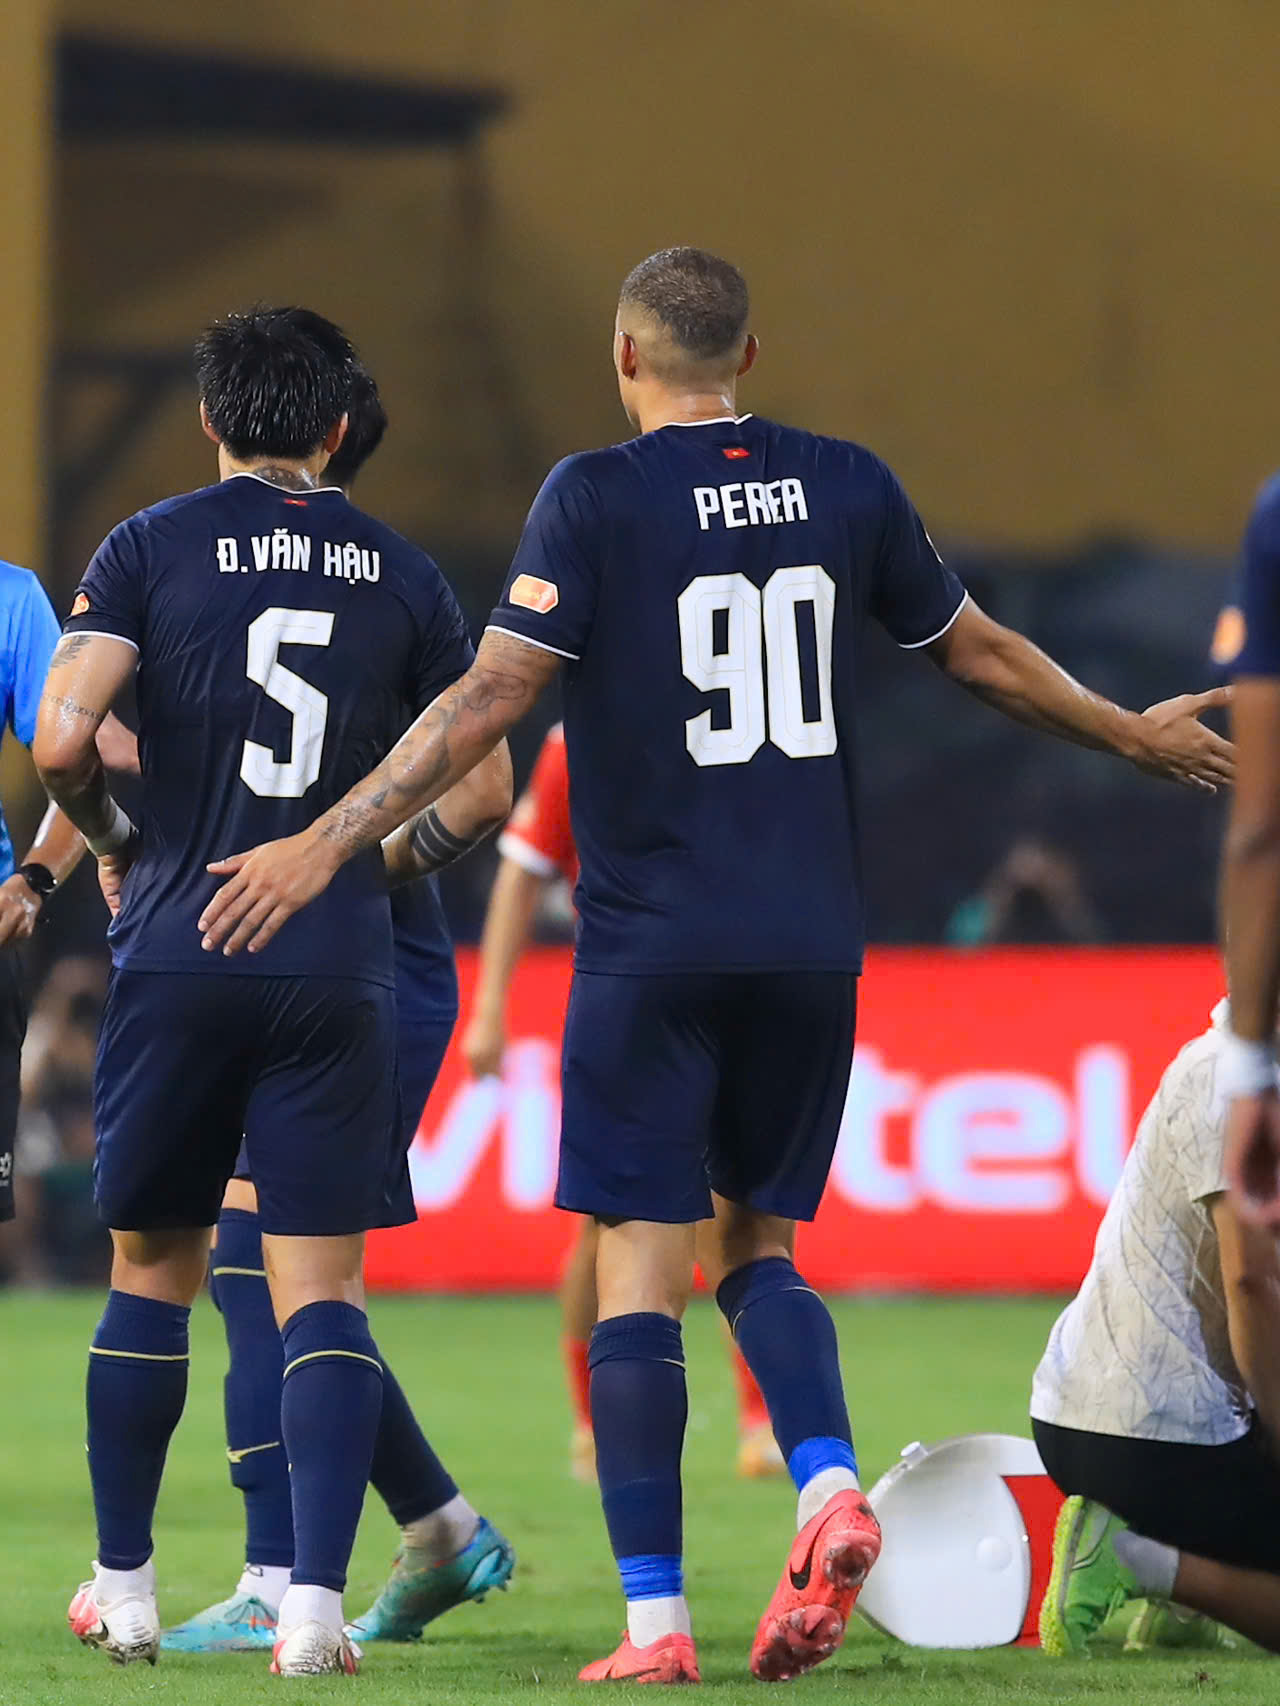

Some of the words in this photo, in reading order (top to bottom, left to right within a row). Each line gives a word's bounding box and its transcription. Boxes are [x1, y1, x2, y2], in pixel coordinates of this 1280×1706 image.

[217, 528, 311, 573] Đ.VĂN
[324, 541, 380, 585] HẬU
[693, 478, 809, 531] PEREA
[239, 606, 336, 798] 5
[677, 564, 838, 767] 90
